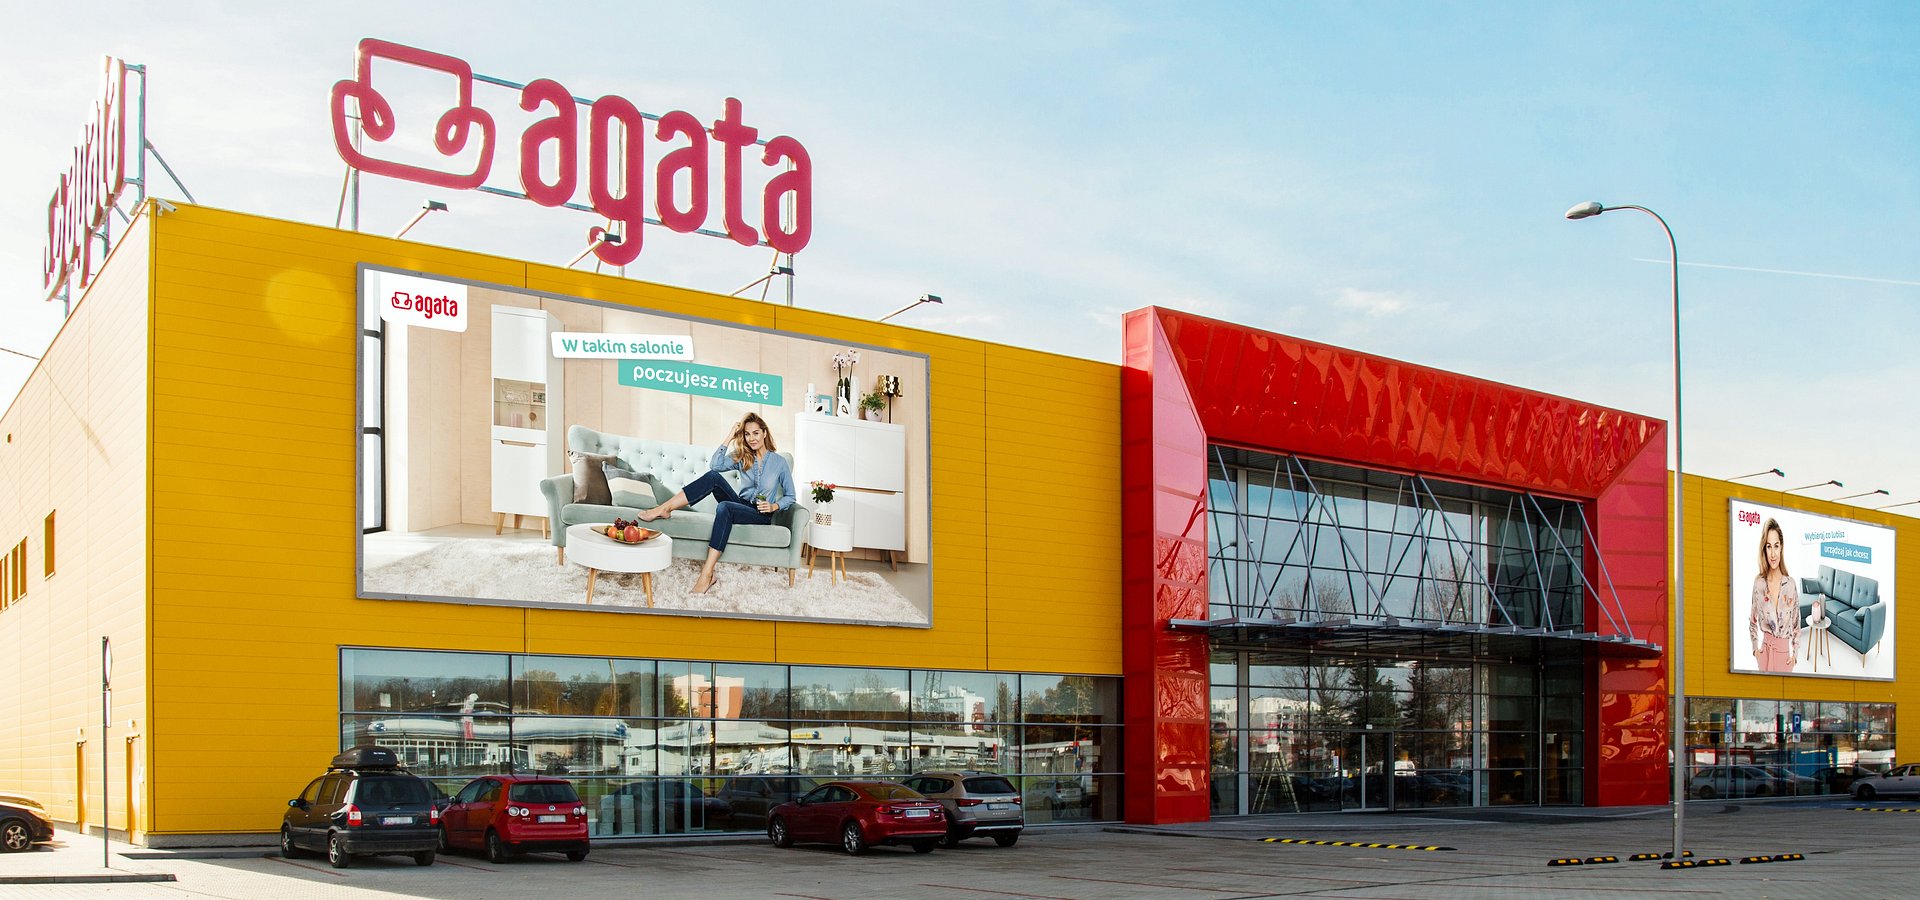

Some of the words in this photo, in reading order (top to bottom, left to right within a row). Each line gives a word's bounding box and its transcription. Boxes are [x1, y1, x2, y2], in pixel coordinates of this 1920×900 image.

[521, 79, 812, 266] agata
[414, 294, 458, 320] agata
[561, 338, 579, 353] W
[582, 337, 627, 354] takim
[630, 340, 684, 355] salonie
[633, 365, 718, 389] poczujesz
[721, 377, 769, 400] miętę
[1745, 511, 1761, 526] agata
[1805, 531, 1825, 542] Wybieraj
[1831, 530, 1845, 539] lubisz
[1844, 547, 1853, 558] jak
